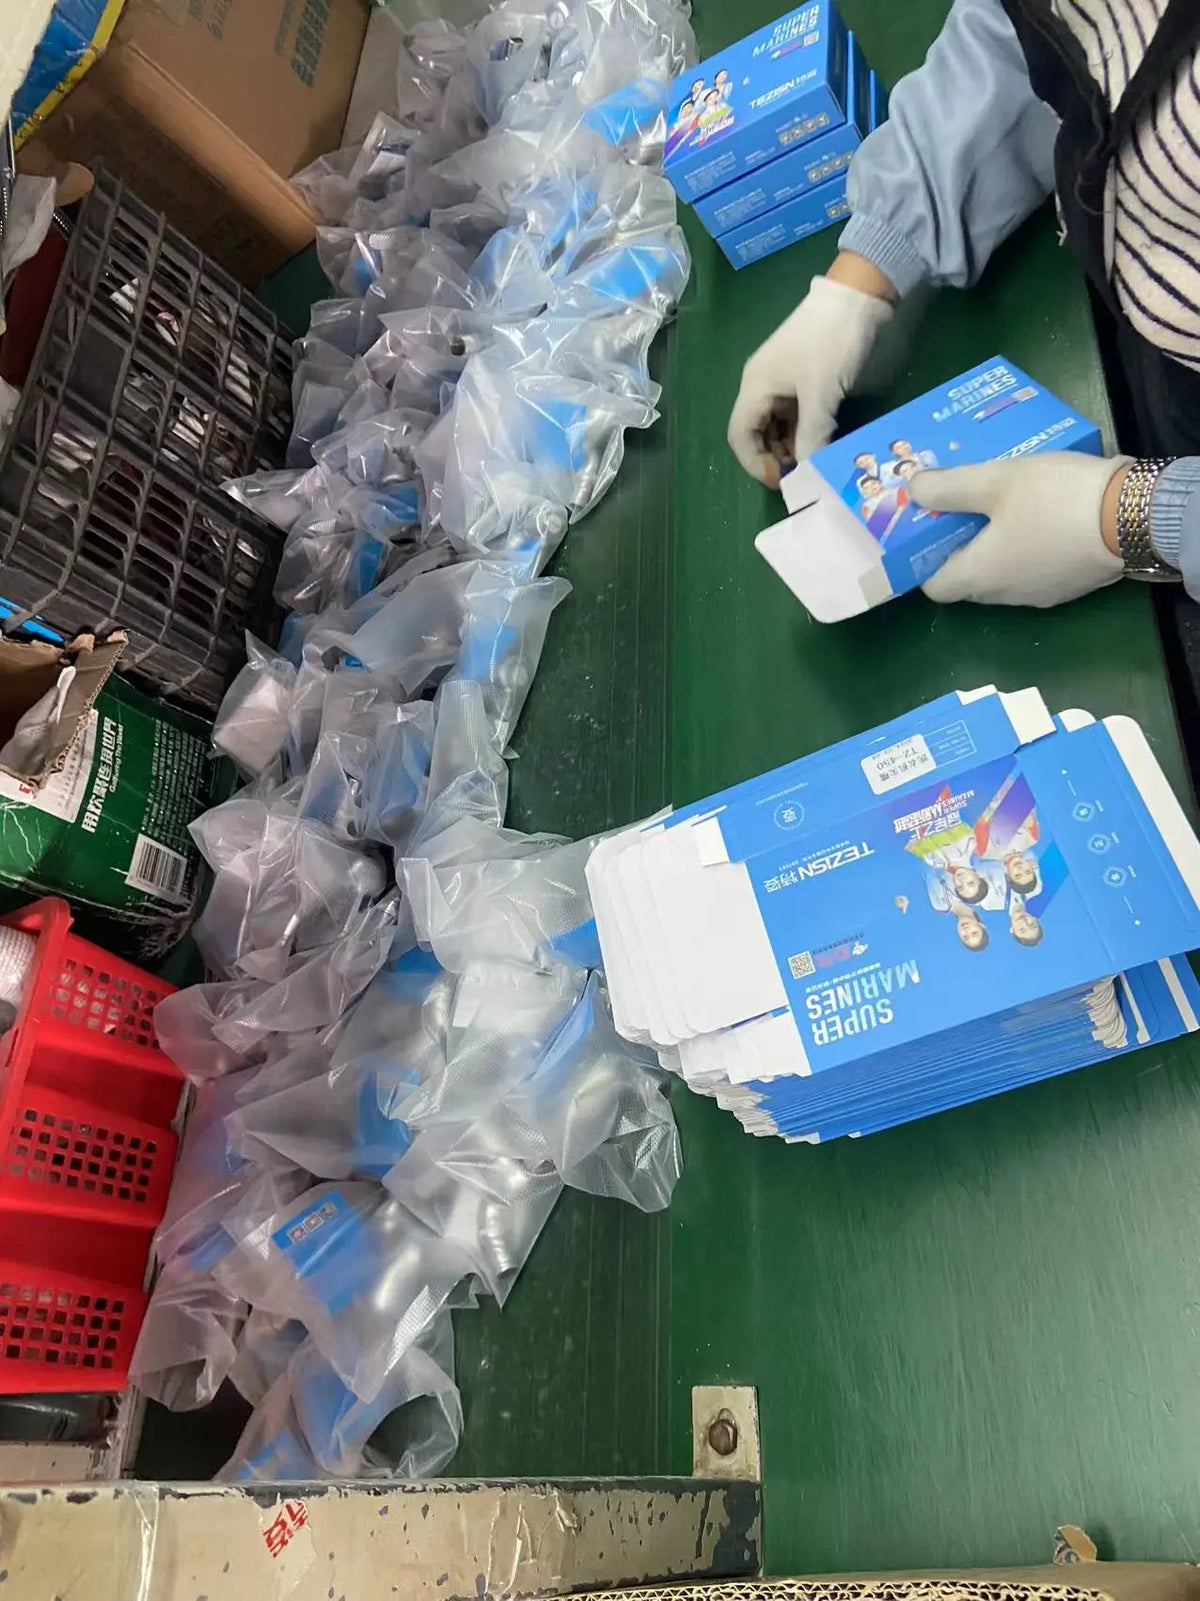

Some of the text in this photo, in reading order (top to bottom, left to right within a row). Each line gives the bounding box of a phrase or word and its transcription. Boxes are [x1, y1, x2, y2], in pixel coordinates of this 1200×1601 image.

[932, 373, 1018, 423] MARINES
[947, 364, 1009, 400] SUPER
[805, 959, 921, 1020] MARINES
[811, 998, 894, 1046] SUPER
